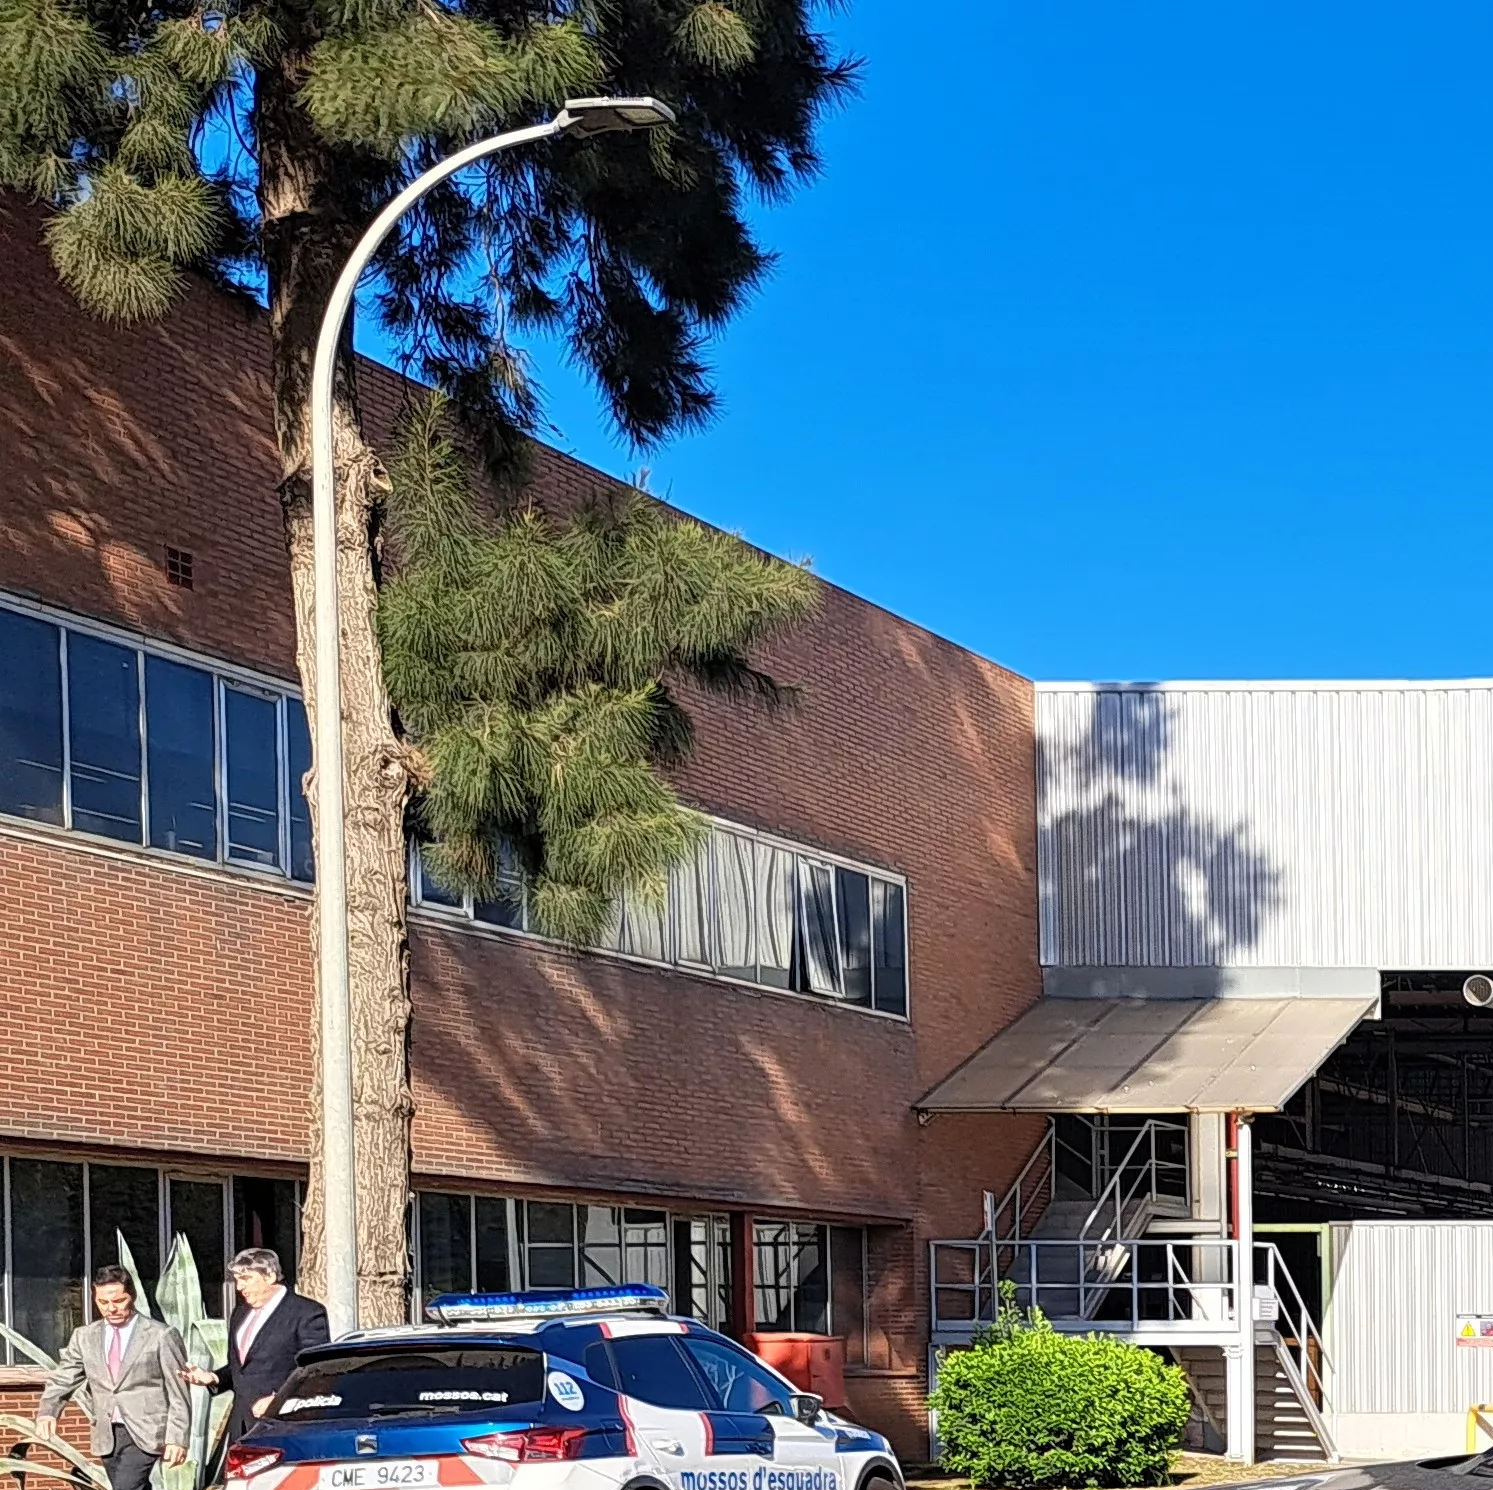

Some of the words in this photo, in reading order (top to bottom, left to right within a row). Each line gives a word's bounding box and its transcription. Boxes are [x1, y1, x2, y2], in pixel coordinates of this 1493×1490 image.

[554, 1381, 577, 1396] 112
[331, 1463, 366, 1488] CME
[377, 1460, 425, 1485] 9423
